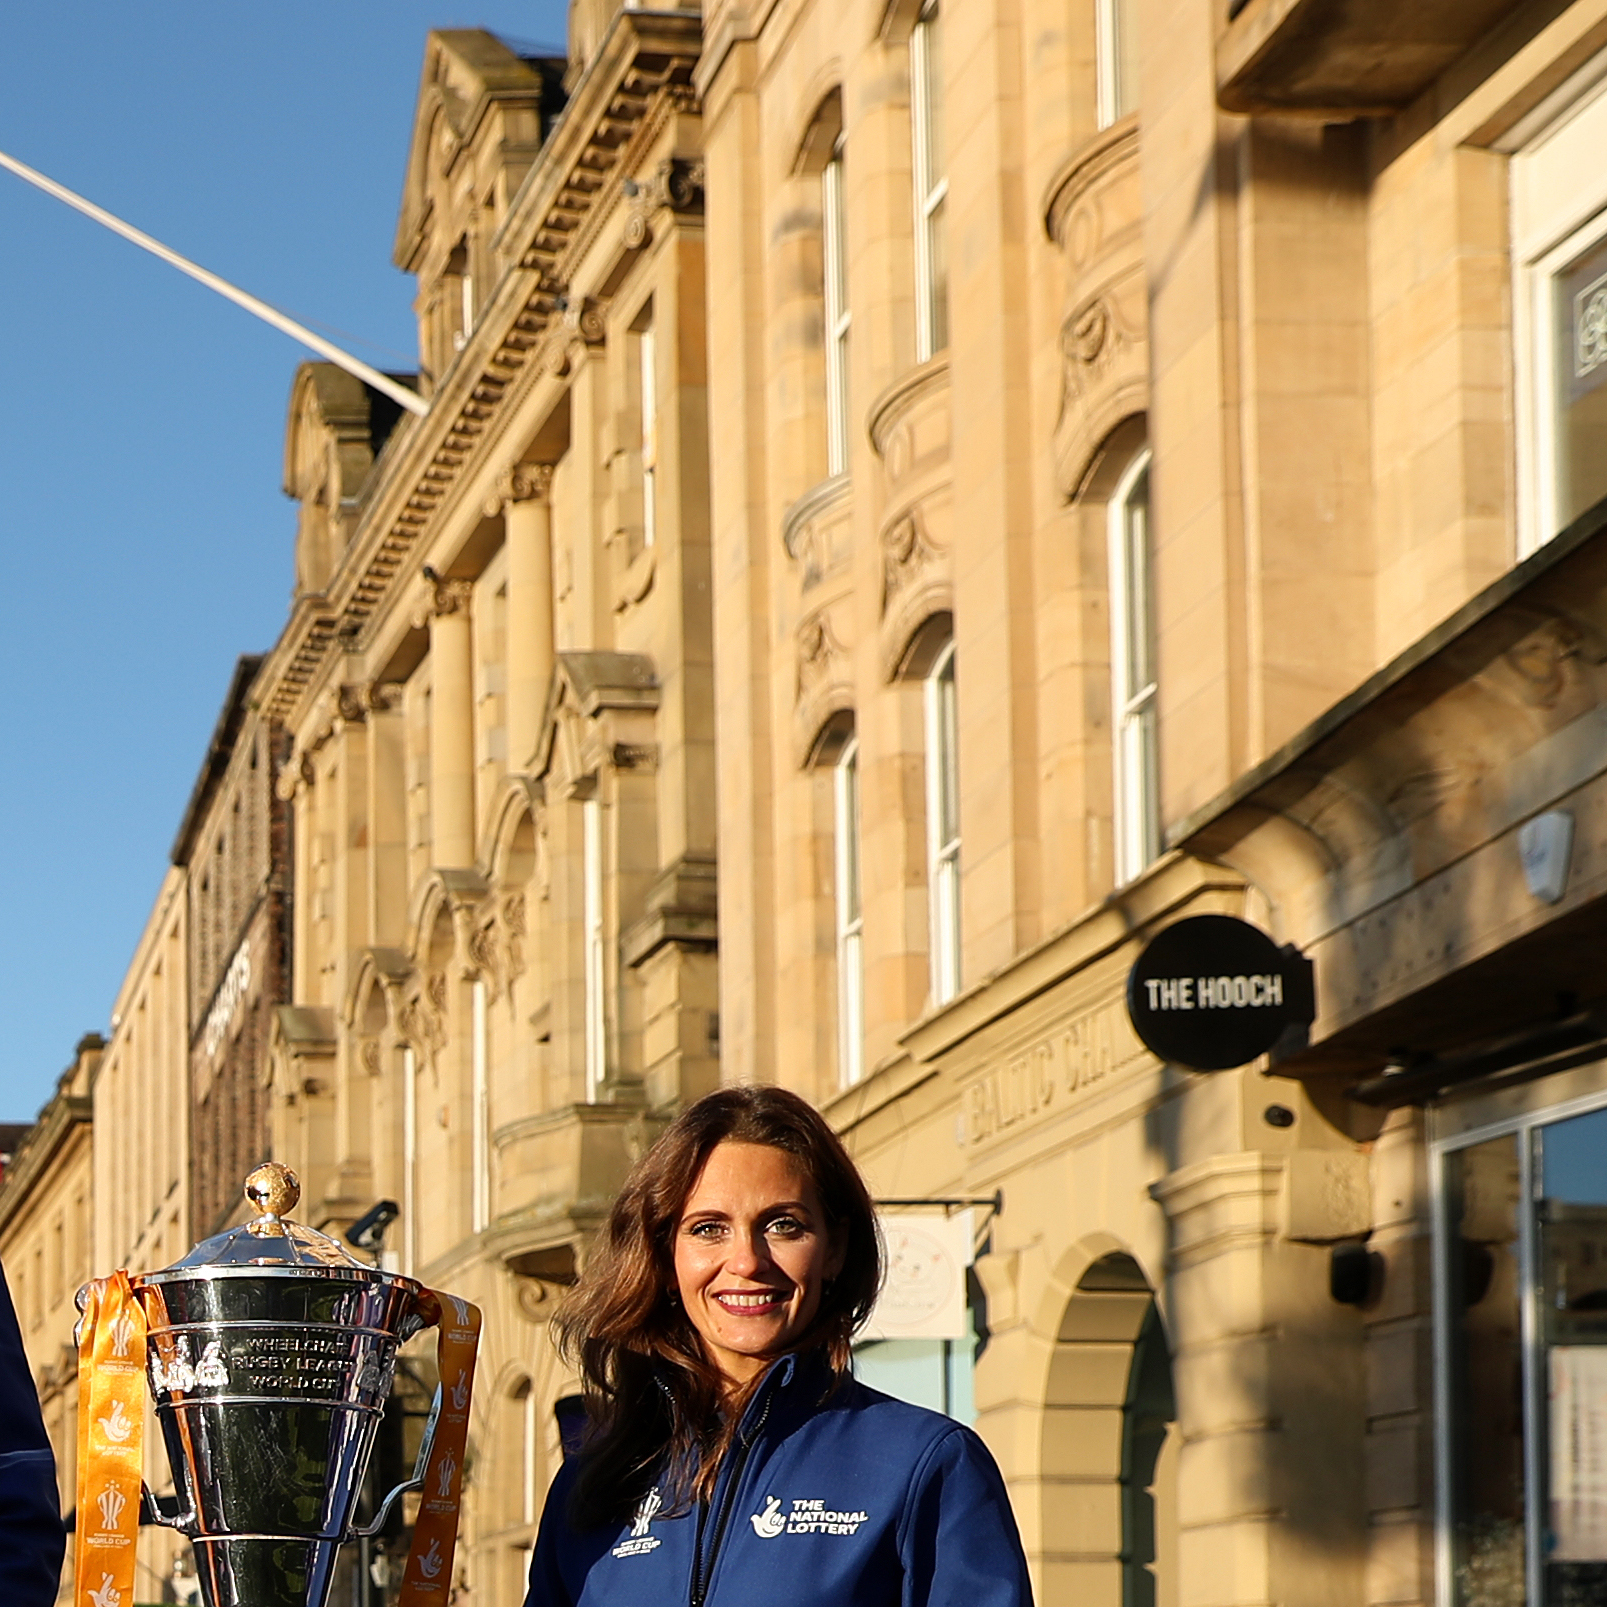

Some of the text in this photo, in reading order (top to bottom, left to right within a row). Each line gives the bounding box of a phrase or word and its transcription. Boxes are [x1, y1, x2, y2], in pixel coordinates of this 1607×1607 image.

[1144, 973, 1284, 1011] THE HOOCH
[231, 1356, 291, 1369] RUGBY
[249, 1375, 309, 1389] WORLD
[792, 1499, 825, 1511] THE
[789, 1510, 869, 1523] NATIONAL
[786, 1522, 859, 1535] LOTTERY
[114, 1537, 131, 1546] CUP
